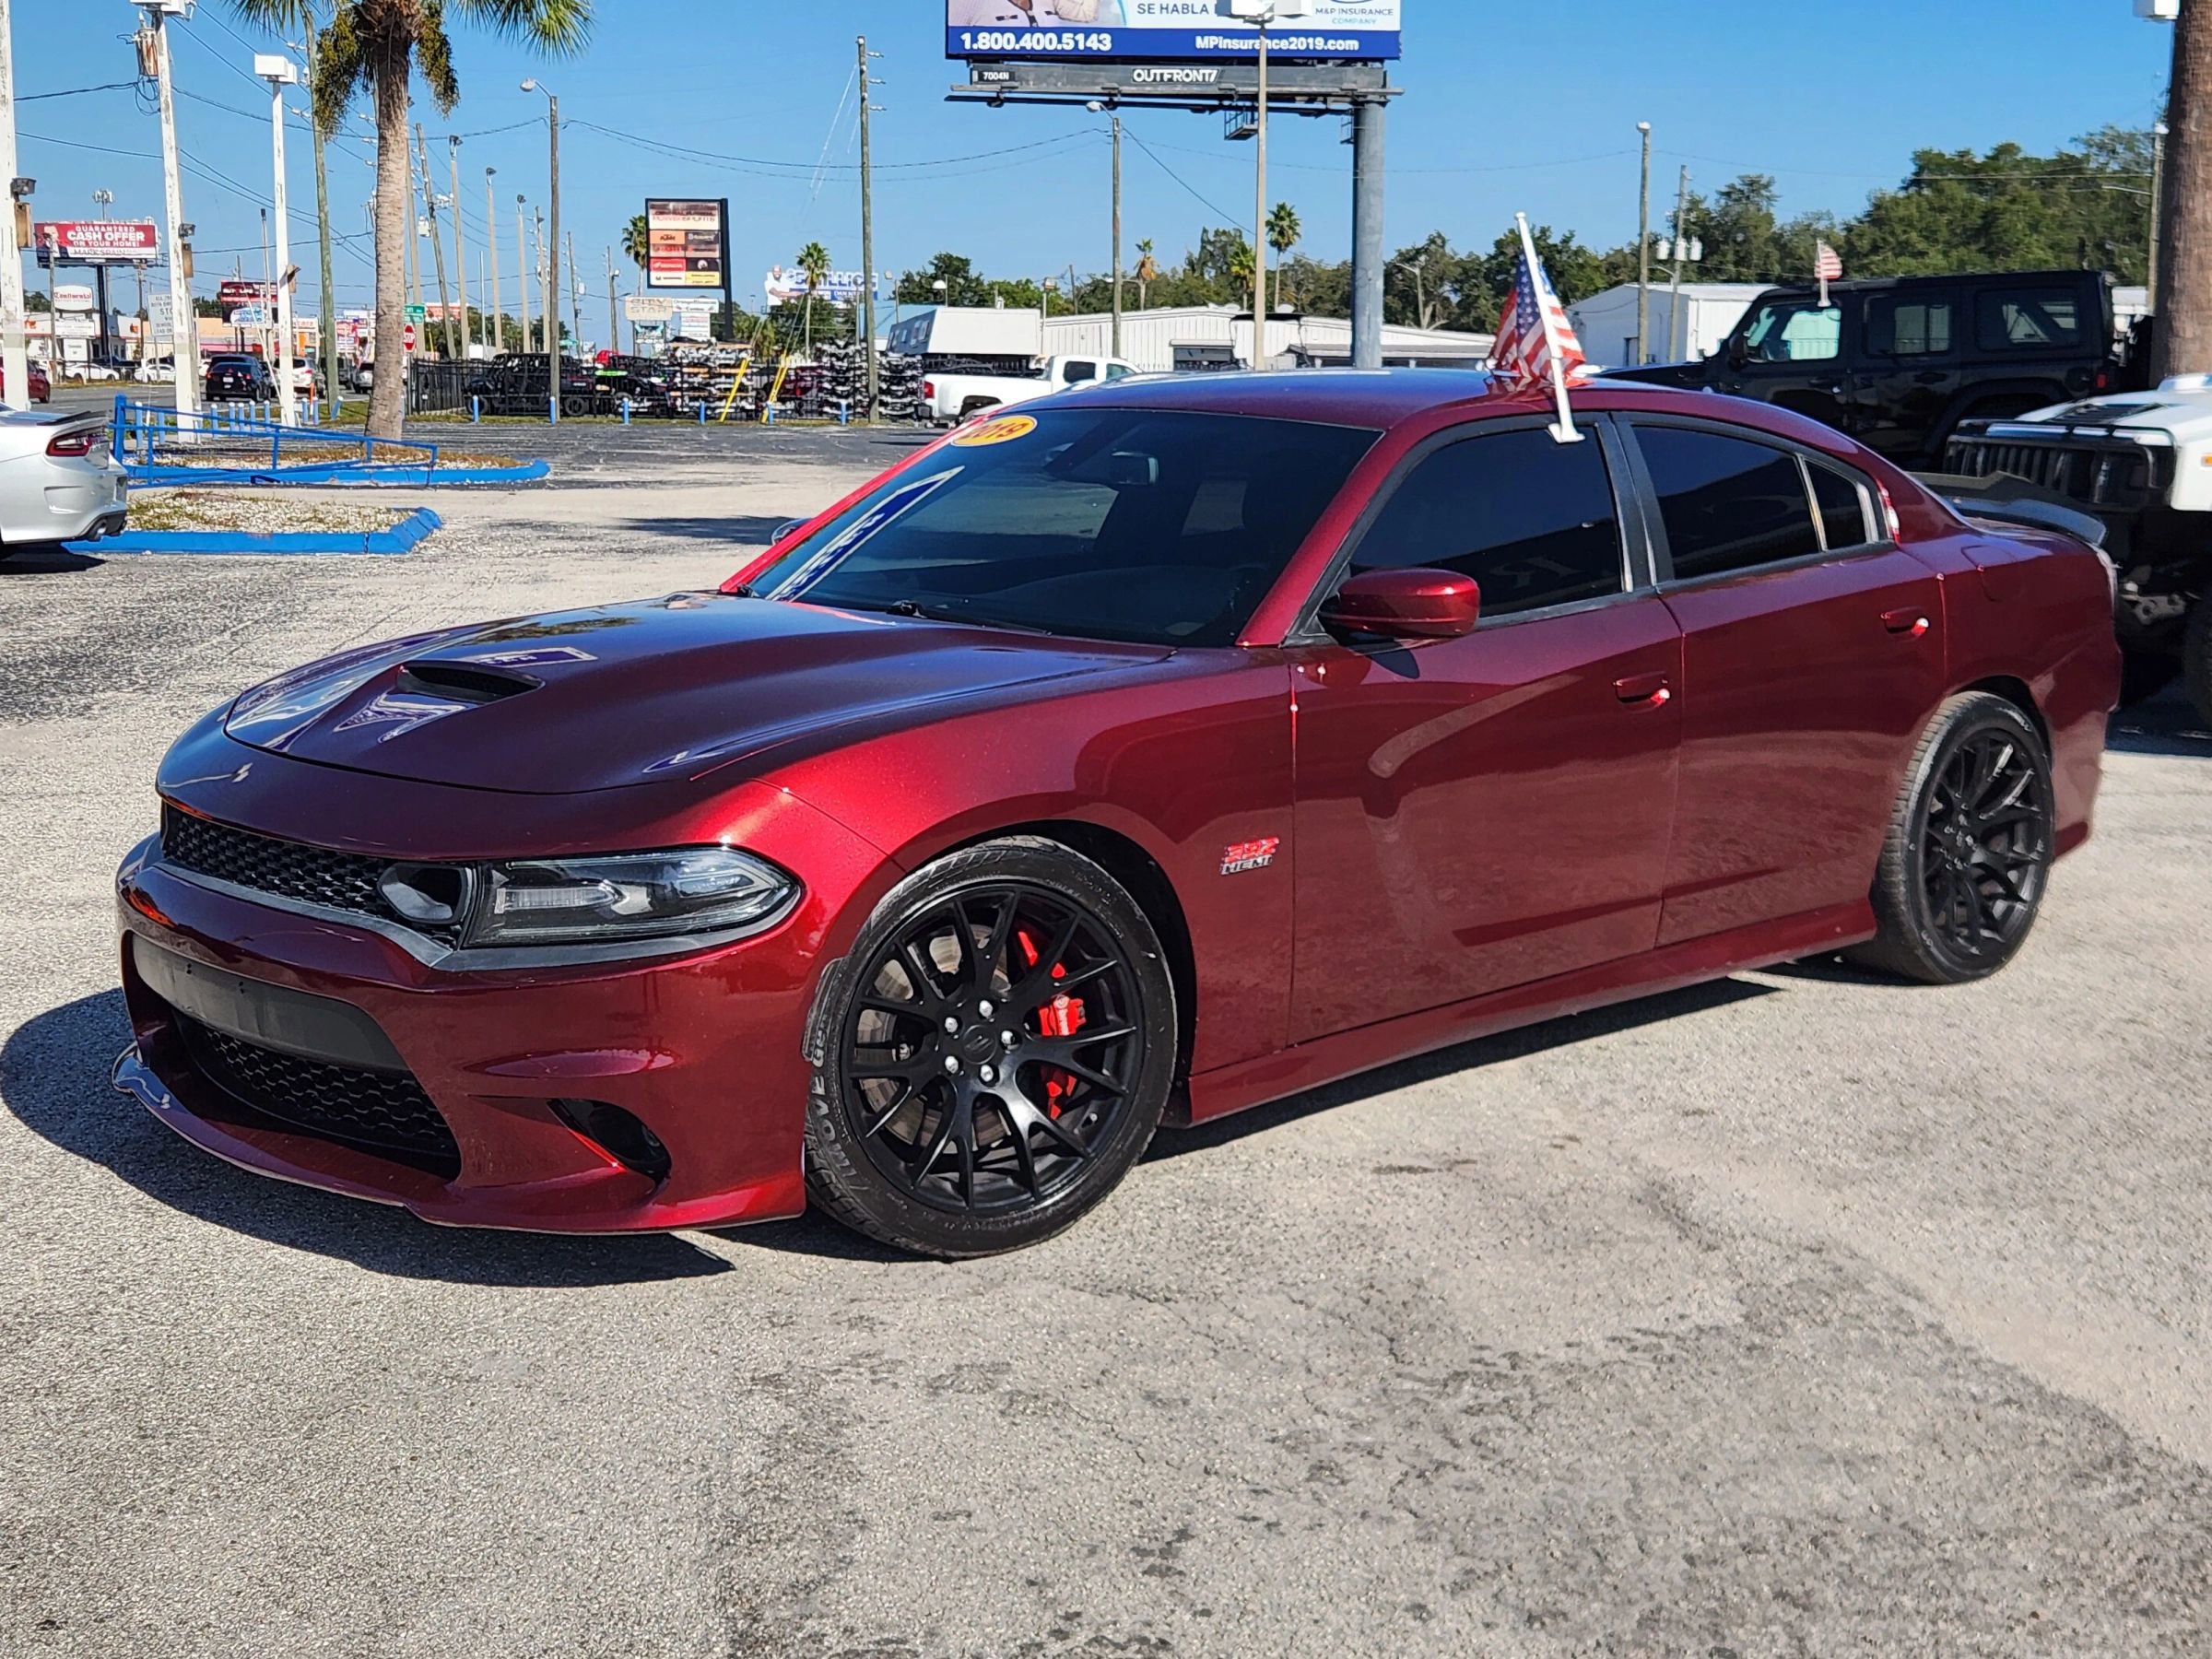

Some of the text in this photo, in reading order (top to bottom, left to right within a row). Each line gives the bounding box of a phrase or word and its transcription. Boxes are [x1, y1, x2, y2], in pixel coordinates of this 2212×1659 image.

[1136, 3, 1156, 15] SE
[1159, 3, 1209, 15] HABLA
[1338, 7, 1394, 16] INSURANCE
[960, 31, 1112, 52] 1.800.400.5143
[982, 71, 1009, 80] 7004N
[67, 231, 145, 241] CASH OFFER
[958, 422, 1030, 440] 2019
